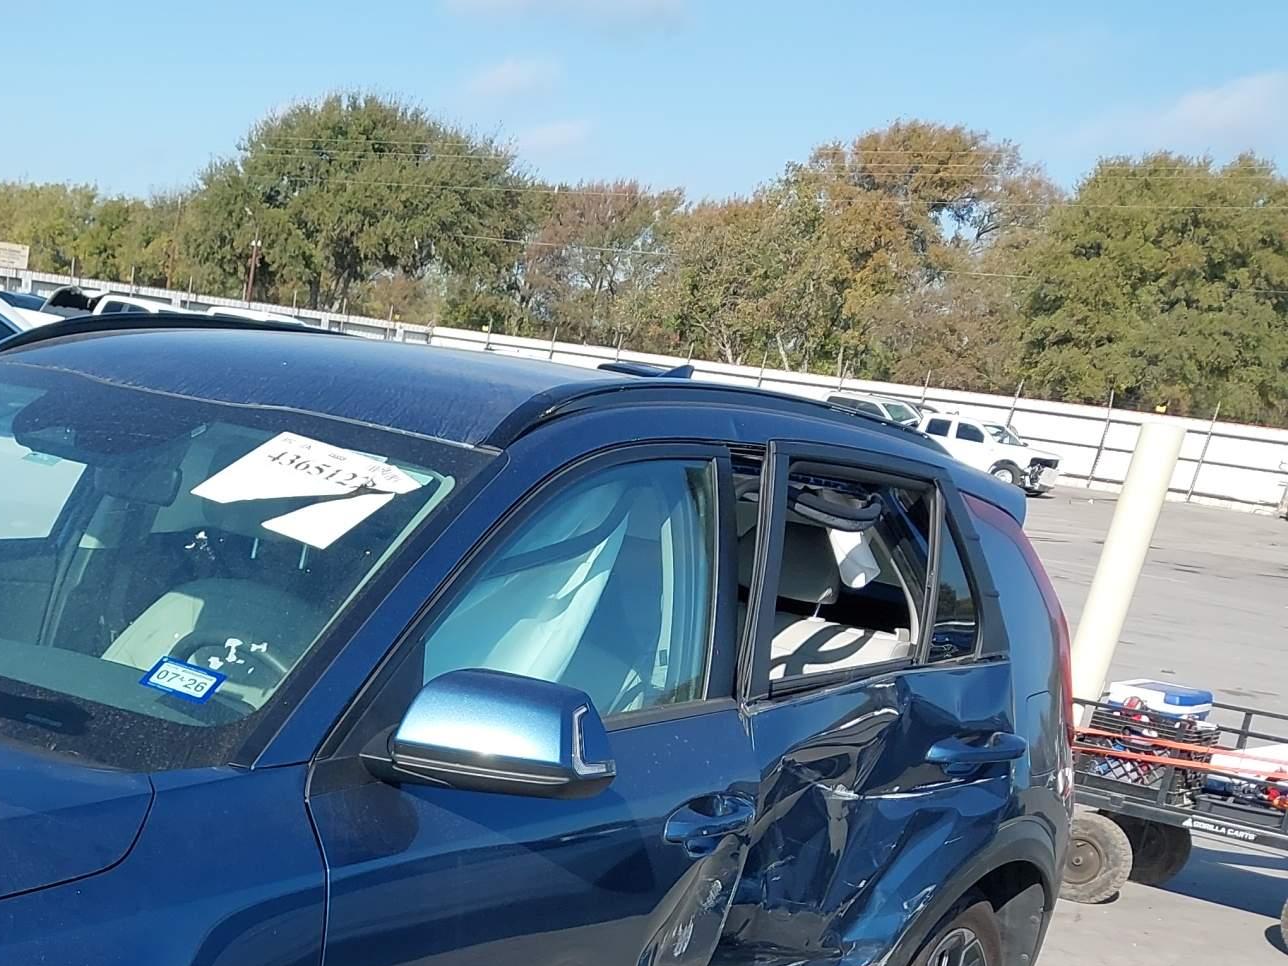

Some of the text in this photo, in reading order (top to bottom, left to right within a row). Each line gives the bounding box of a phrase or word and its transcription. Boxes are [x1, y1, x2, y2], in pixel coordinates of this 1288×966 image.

[156, 669, 181, 683] 07
[182, 678, 208, 693] 26
[1193, 820, 1257, 840] GORILLA CARTS
